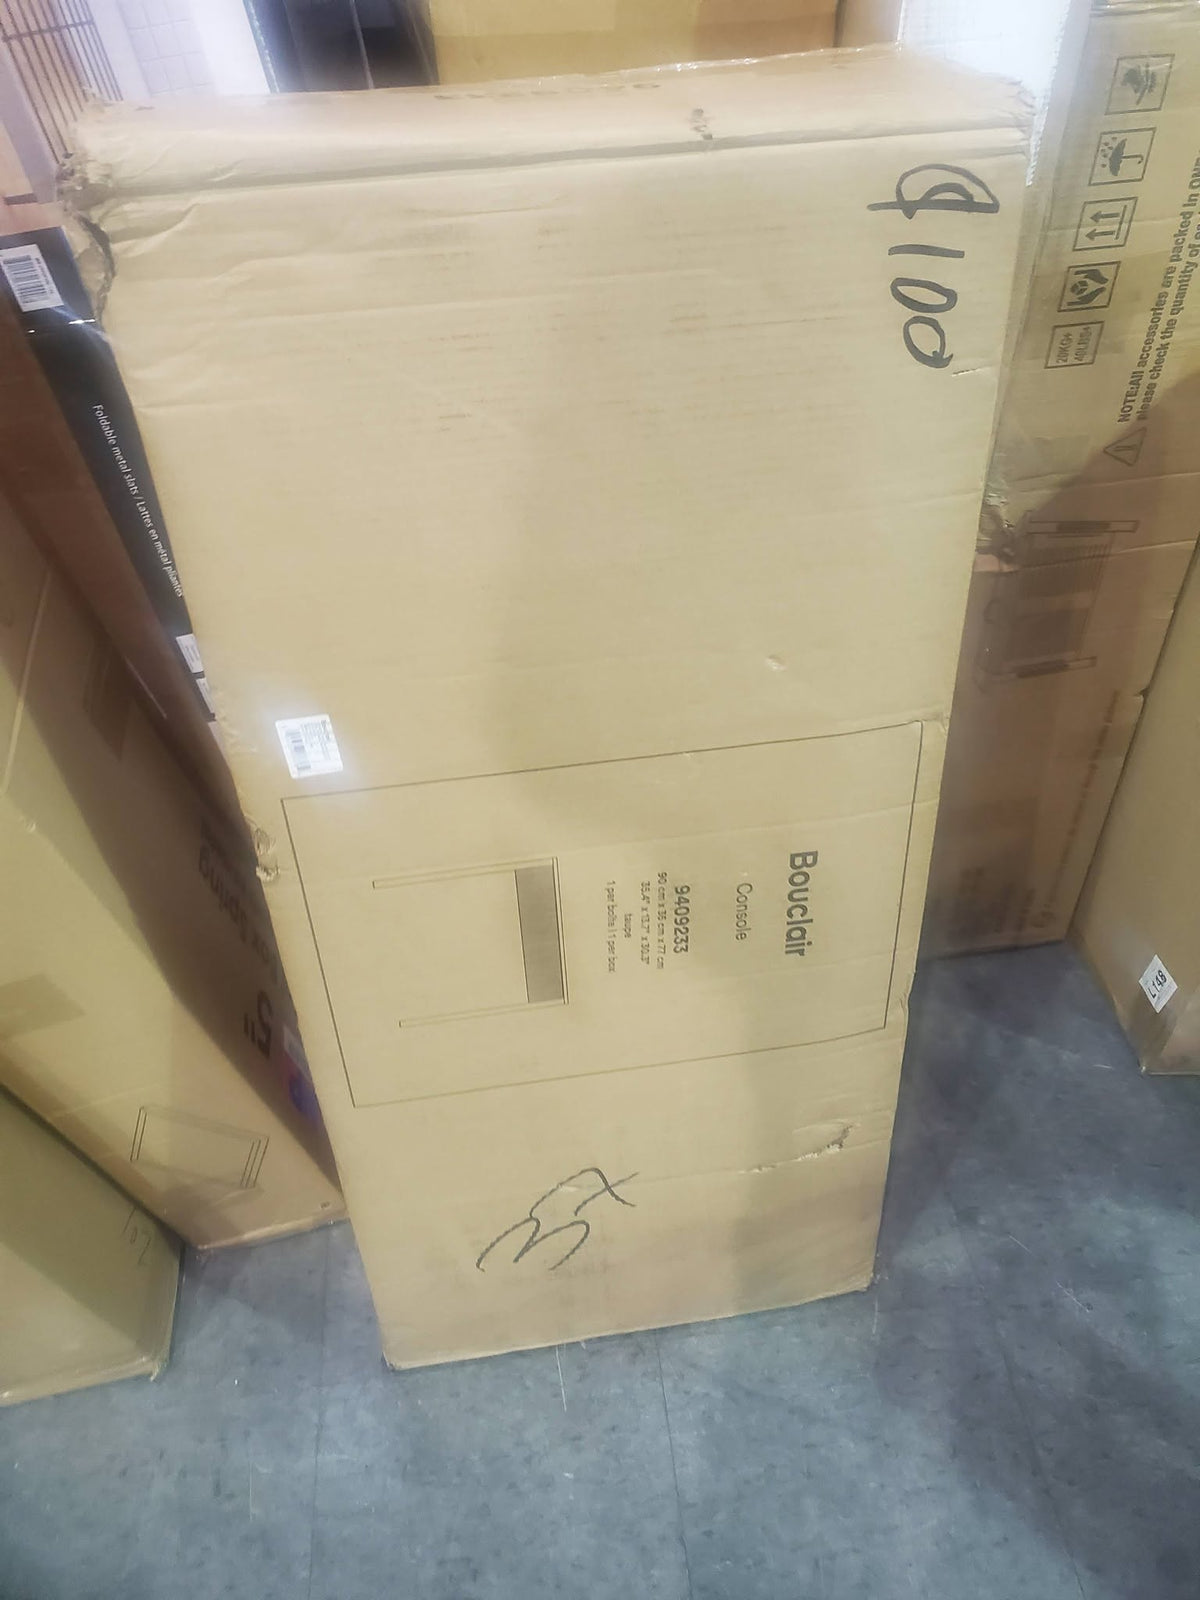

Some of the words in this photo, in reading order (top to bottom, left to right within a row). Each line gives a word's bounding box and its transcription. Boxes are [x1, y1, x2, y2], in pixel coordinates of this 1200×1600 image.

[866, 163, 1000, 369] $100
[1137, 291, 1169, 368] accessories
[1161, 265, 1177, 288] are
[1170, 210, 1195, 262] packed
[1136, 382, 1157, 421] please
[1149, 341, 1170, 380] check
[1160, 318, 1178, 340] the
[1170, 260, 1199, 316] quantity
[1187, 243, 1200, 258] of
[92, 404, 117, 445] Foldable
[111, 446, 132, 473] metal
[123, 473, 139, 495] slats
[136, 501, 154, 528] Lattes
[148, 529, 159, 541] en
[162, 565, 184, 598] pliantes
[657, 871, 668, 885] 90
[673, 885, 691, 954] 9409233
[735, 882, 753, 941] Console
[784, 850, 818, 957] Bouclair
[623, 912, 632, 939] taupe
[1147, 969, 1168, 999] L148
